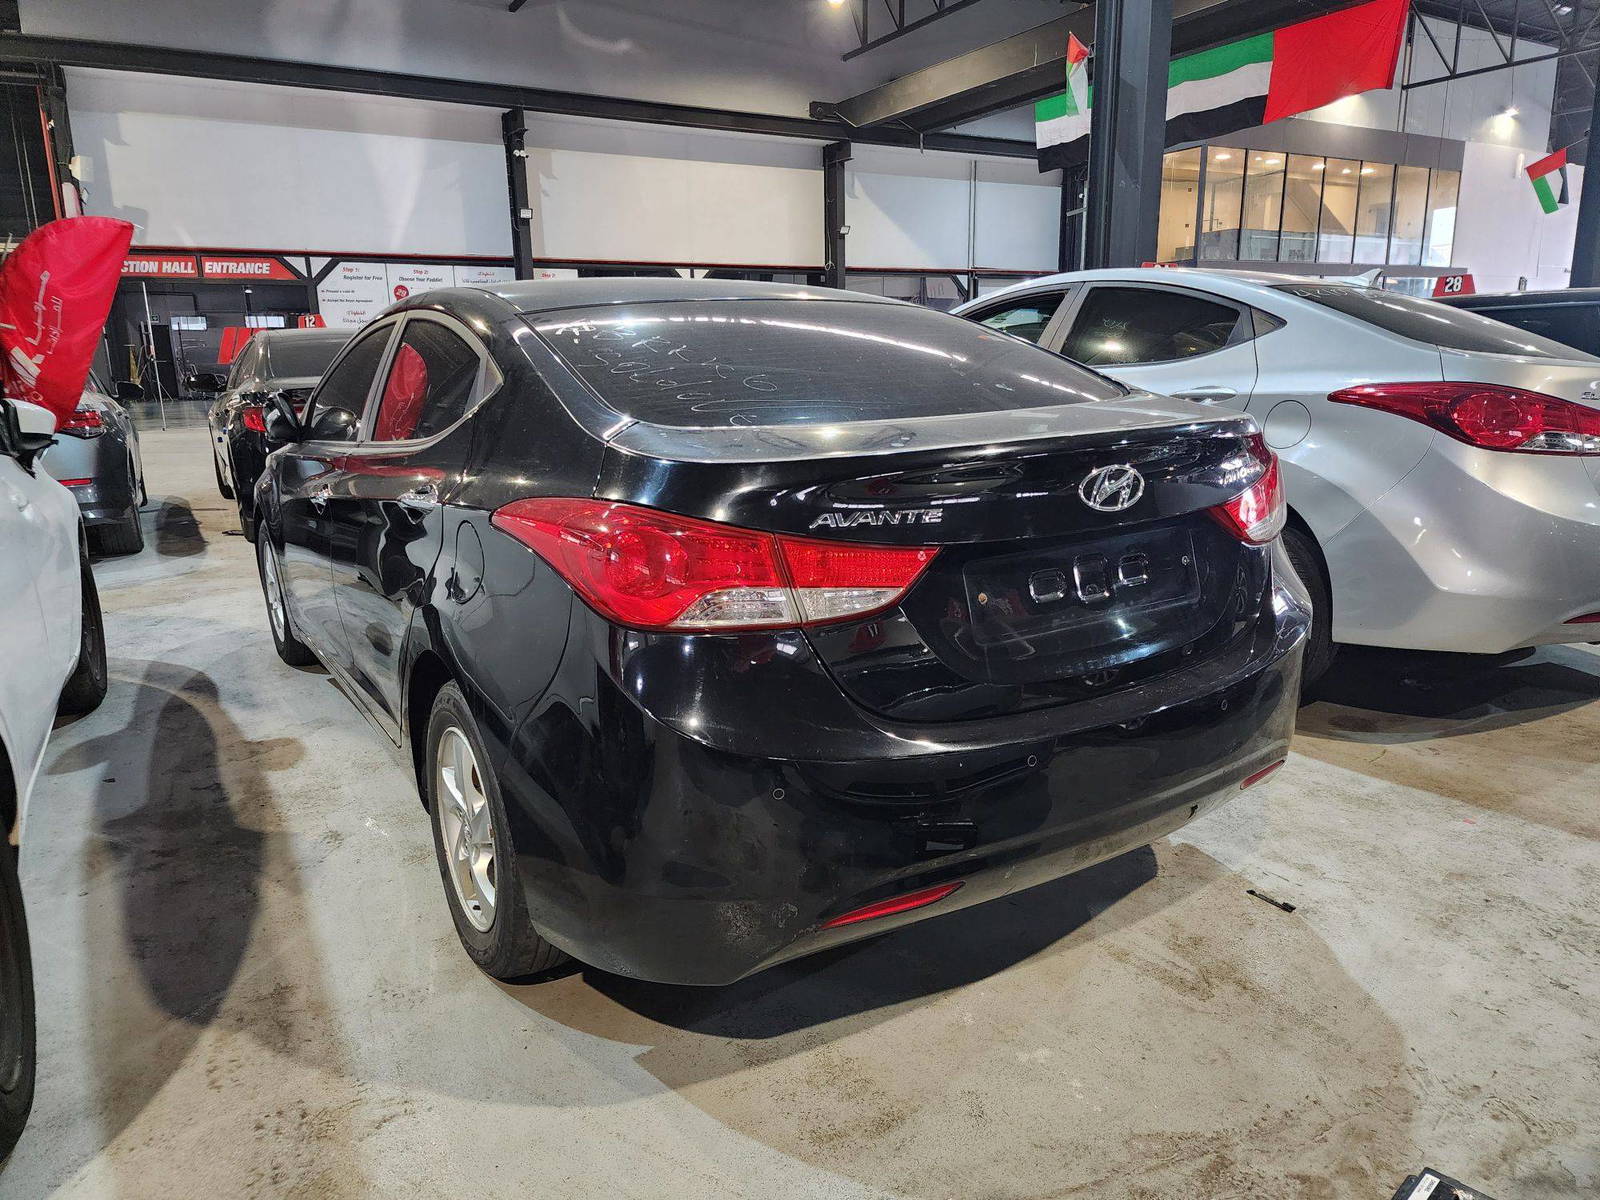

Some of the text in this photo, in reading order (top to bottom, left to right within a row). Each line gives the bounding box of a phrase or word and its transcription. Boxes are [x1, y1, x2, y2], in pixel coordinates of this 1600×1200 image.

[162, 260, 195, 274] HALL
[204, 260, 271, 275] ENTRANCE
[1444, 276, 1463, 293] 28
[304, 315, 316, 328] 12
[809, 508, 944, 529] AVANTE
